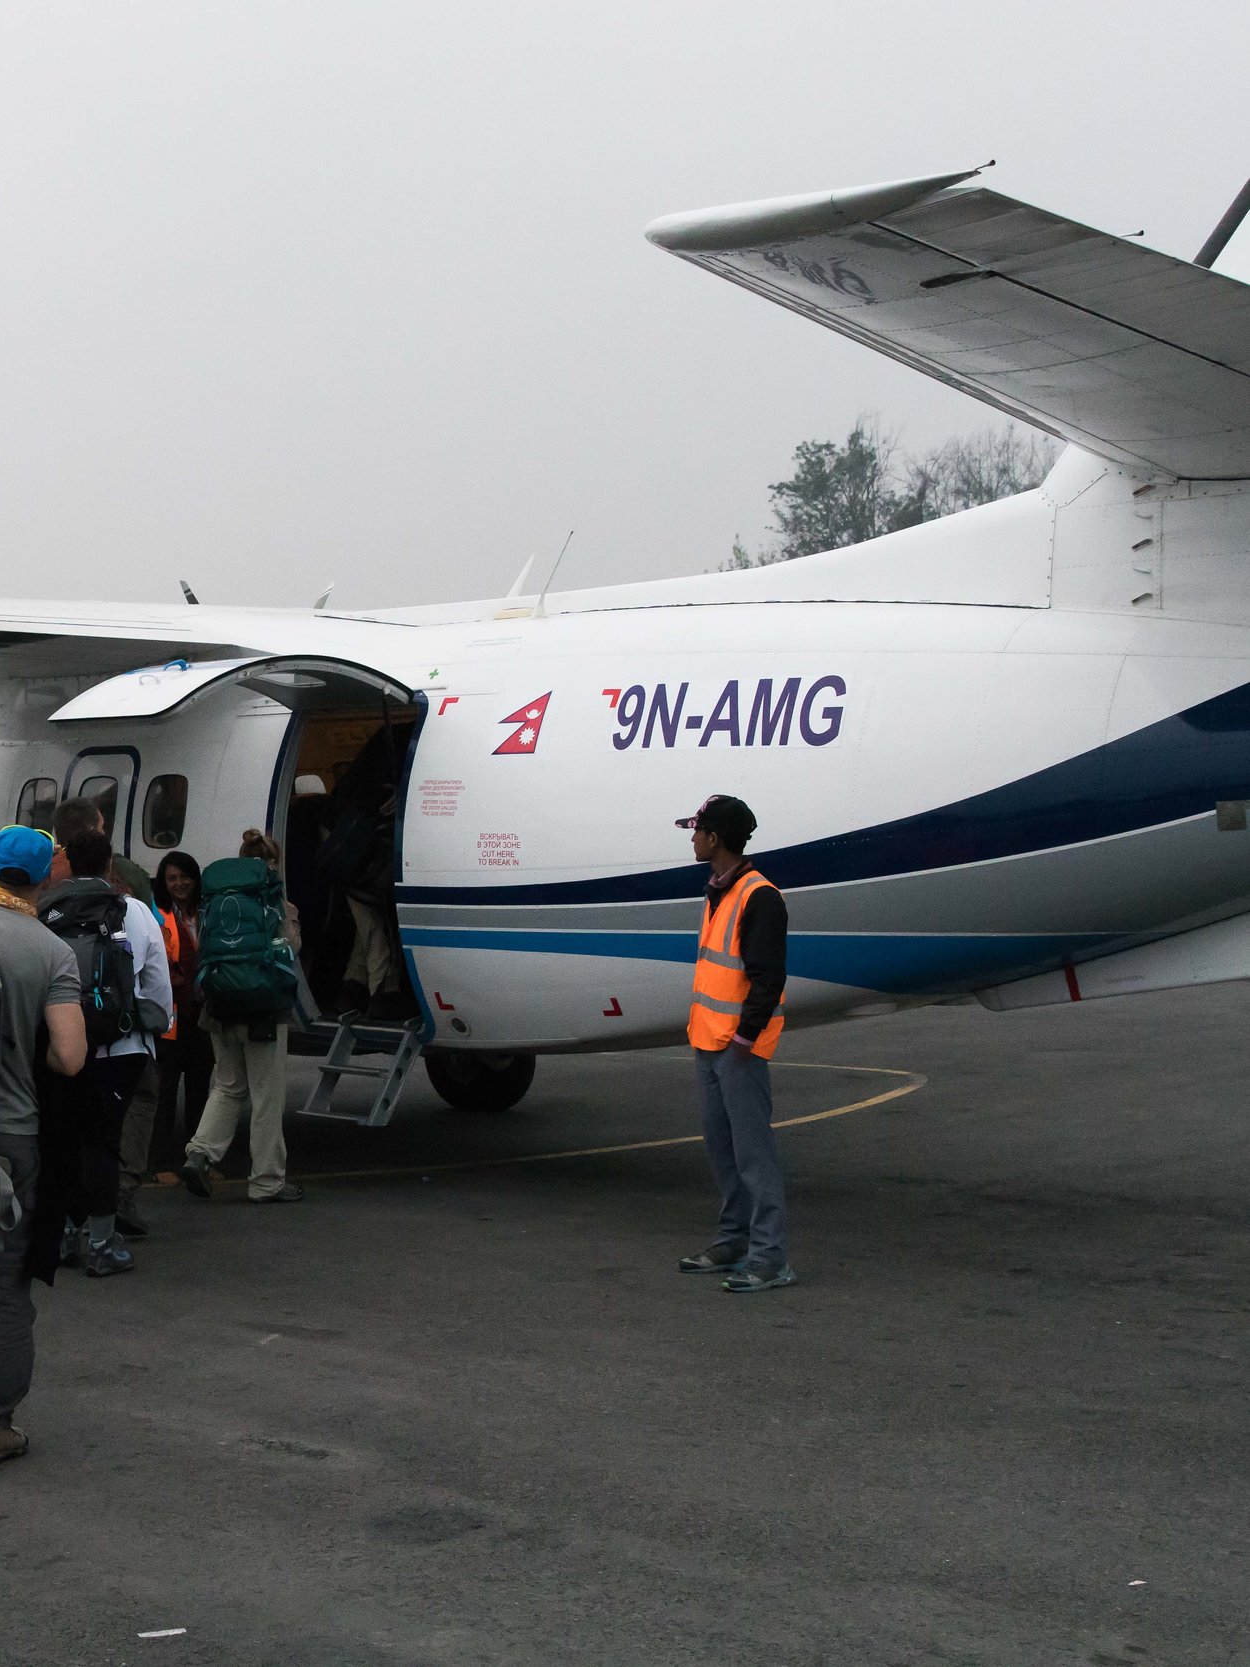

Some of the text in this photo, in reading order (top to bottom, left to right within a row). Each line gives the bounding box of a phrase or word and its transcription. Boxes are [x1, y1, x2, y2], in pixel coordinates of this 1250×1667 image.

[612, 674, 847, 751] 9N-AMG
[480, 833, 519, 841] ВСКРЫВАТЬ
[502, 841, 521, 849] ЗОНЕ
[481, 850, 515, 858] CUT HERE
[488, 858, 511, 866] BREAK
[512, 858, 520, 866] IN
